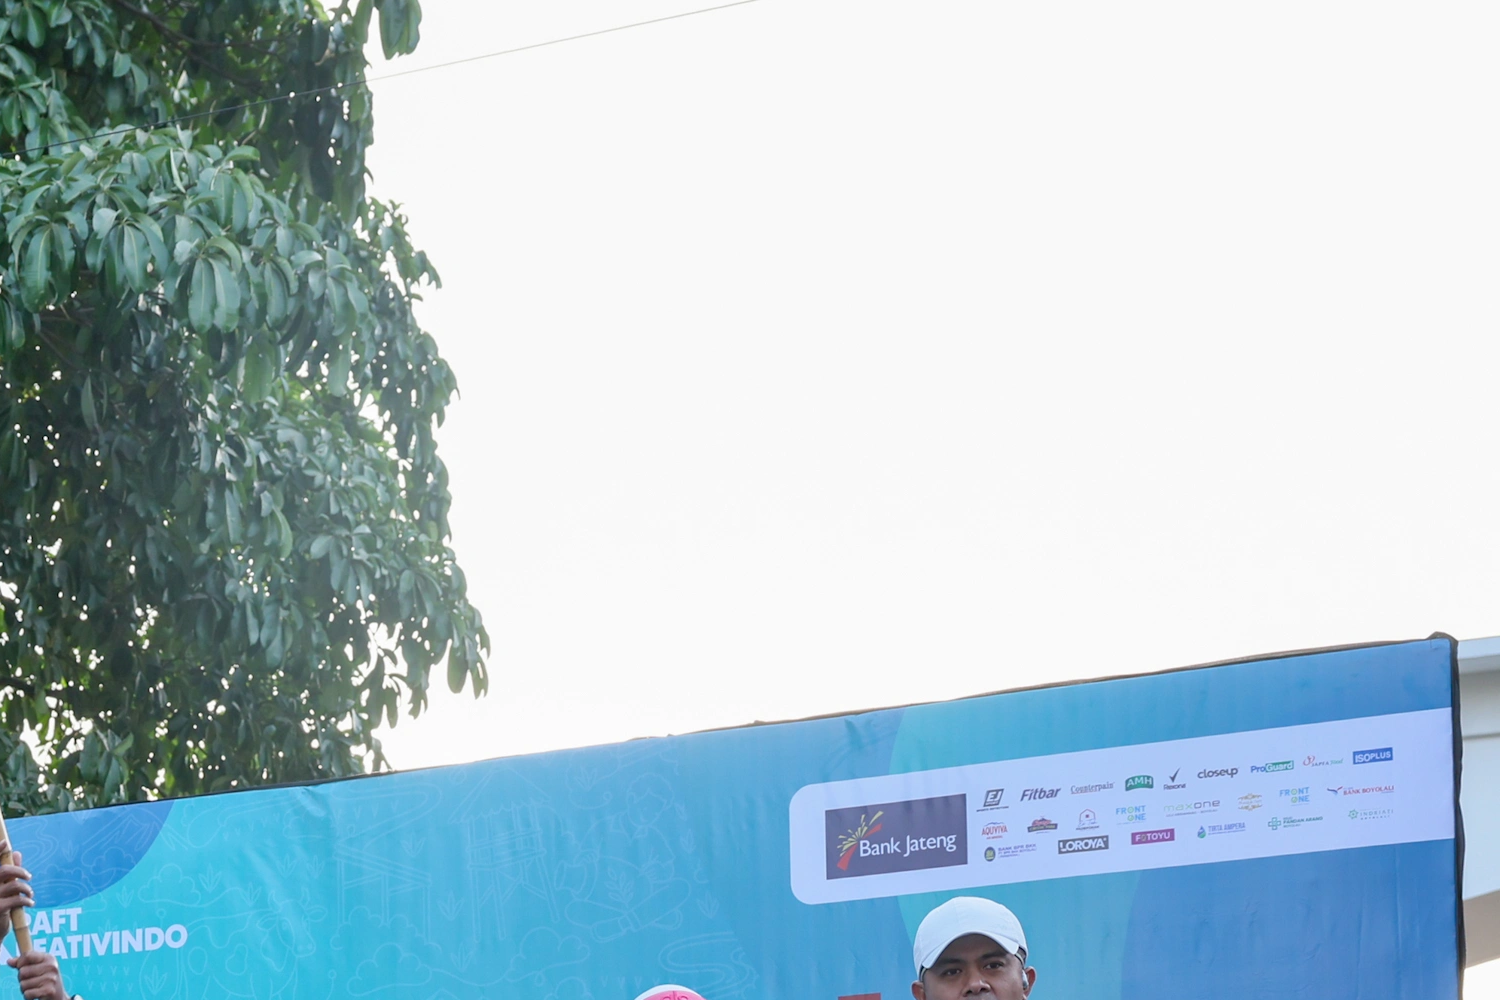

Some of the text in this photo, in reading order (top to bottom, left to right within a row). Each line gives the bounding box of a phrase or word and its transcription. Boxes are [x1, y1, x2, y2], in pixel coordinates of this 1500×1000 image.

[1354, 751, 1392, 764] ISOPLUS
[1197, 767, 1239, 779] closeup
[1250, 761, 1293, 773] ProGuard
[1070, 781, 1115, 795] Counterpain
[1126, 776, 1153, 788] AMH
[1020, 788, 1061, 802] Fitbar
[1279, 786, 1310, 798] FRONT
[1362, 785, 1395, 794] BOYOLALI
[1290, 794, 1310, 804] ONE
[1115, 805, 1147, 816] FRONT
[1163, 799, 1221, 812] maxone
[1127, 813, 1147, 822] ONE
[981, 825, 1008, 836] AQUVIVA
[1223, 822, 1246, 831] AMPERA
[1135, 831, 1171, 842] FOTOYU
[859, 834, 957, 857] Bank Jateng
[1060, 838, 1105, 852] LOROYA
[16, 924, 188, 960] EATIVINDO
